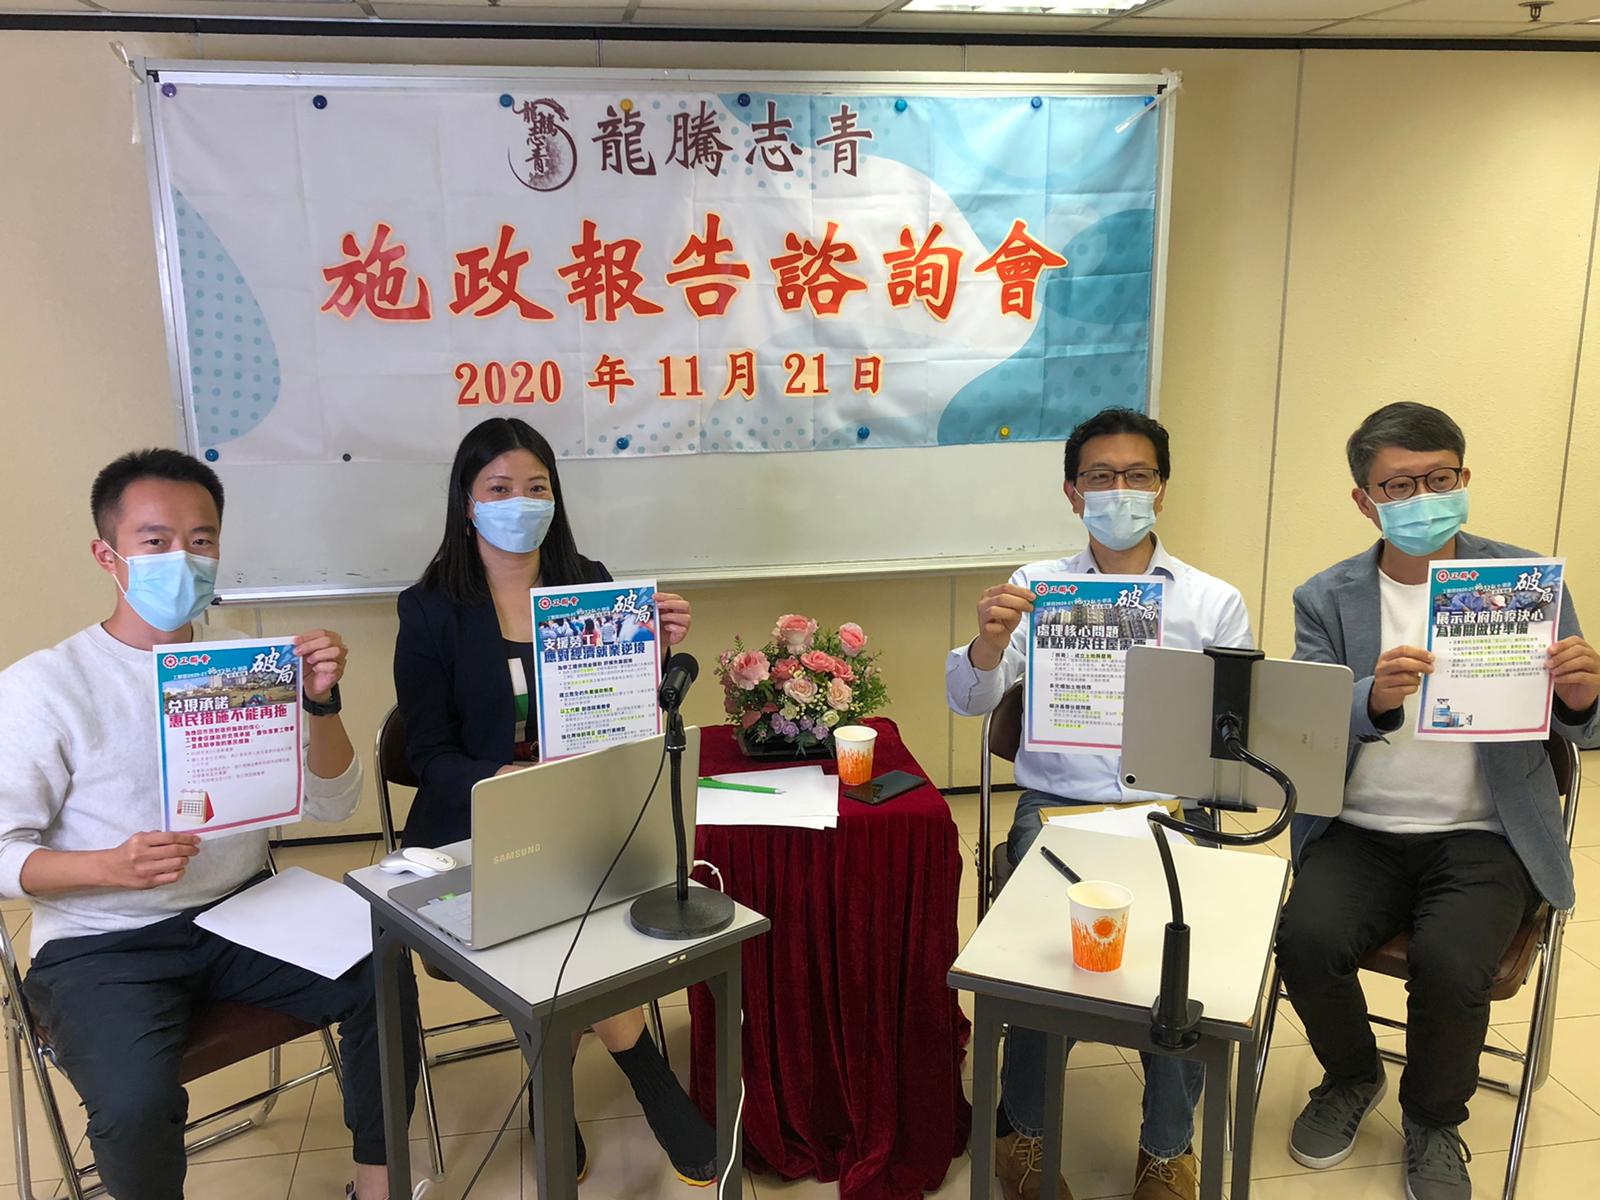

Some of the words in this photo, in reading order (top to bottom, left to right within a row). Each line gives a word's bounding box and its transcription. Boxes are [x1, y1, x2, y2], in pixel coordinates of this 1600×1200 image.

[592, 101, 873, 177] 龍騰志青
[321, 213, 1069, 322] 施政報告諮詢會
[455, 361, 562, 405] 2020
[587, 354, 635, 404] 年
[659, 355, 703, 397] 11
[724, 351, 756, 401] 月
[784, 353, 830, 395] 21
[854, 355, 884, 395] 日
[1436, 610, 1544, 625] 展示政府防疫決心
[1037, 624, 1119, 638] 處理核心問題
[1436, 622, 1529, 638] 為通關做好準備
[543, 634, 596, 650] 支援勞工
[544, 642, 646, 663] 應對經濟就業逆境
[168, 696, 229, 714] 兌現承諾
[169, 705, 288, 728] 惠民措施不能再拖
[493, 843, 541, 865] SAMSUNG
